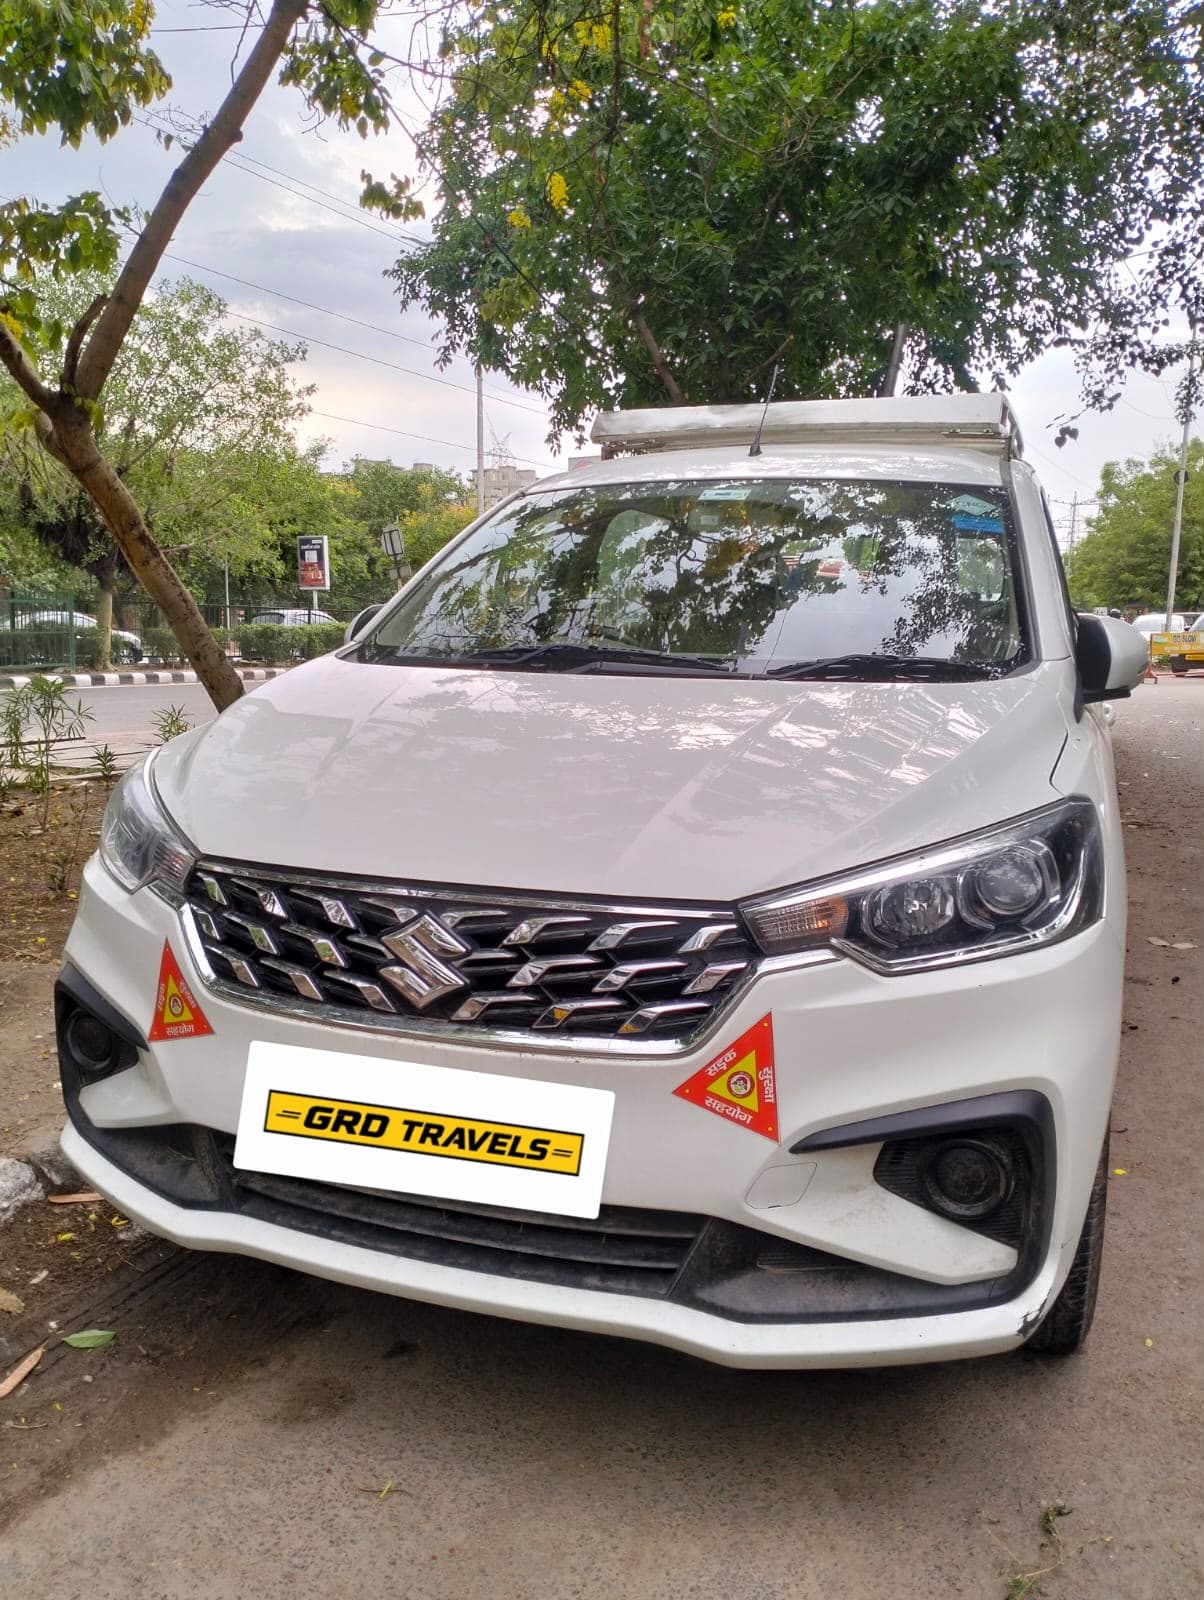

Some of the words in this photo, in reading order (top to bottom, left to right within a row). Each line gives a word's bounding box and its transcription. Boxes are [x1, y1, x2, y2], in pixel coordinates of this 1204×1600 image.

[1182, 634, 1198, 643] SLOW
[166, 1024, 195, 1037] सहयोग
[705, 1049, 737, 1077] सड़क
[758, 1066, 775, 1104] सुरक्षा
[704, 1095, 753, 1125] सहयोग
